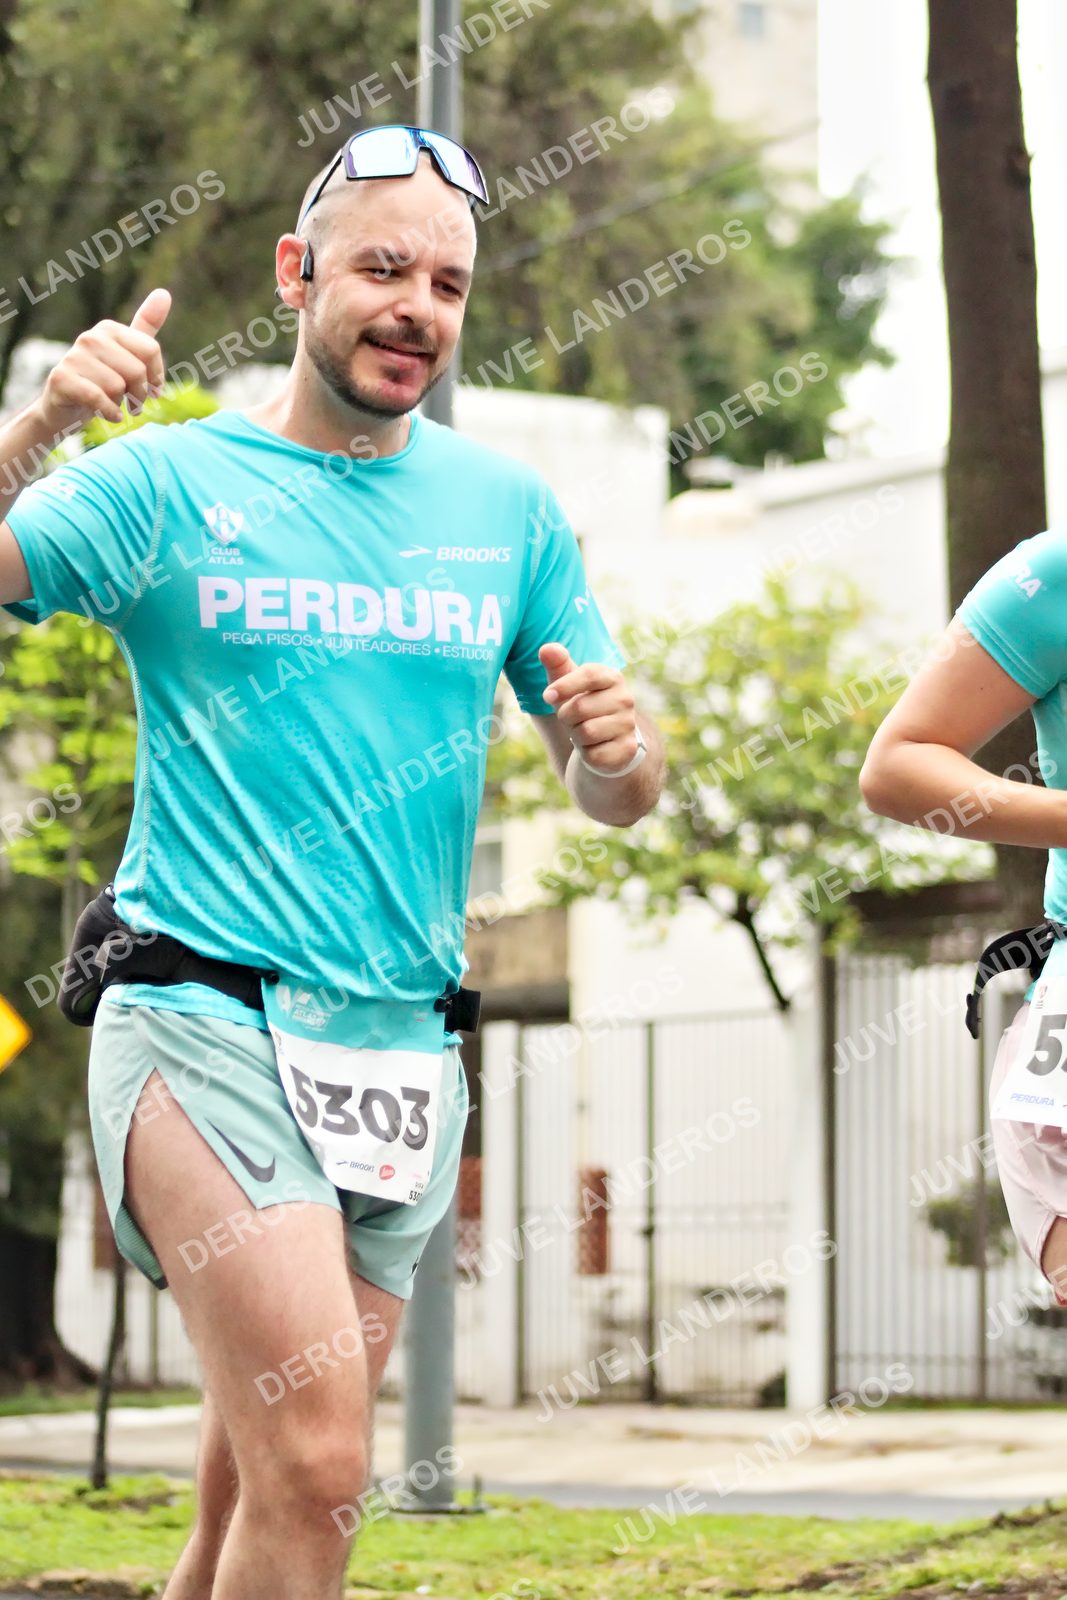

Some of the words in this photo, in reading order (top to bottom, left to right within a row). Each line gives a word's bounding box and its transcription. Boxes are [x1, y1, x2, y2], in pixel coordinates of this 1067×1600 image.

[211, 547, 240, 556] CLUB
[436, 546, 512, 563] BROOKS
[208, 556, 244, 565] ATLAS
[222, 632, 263, 645] PEGA
[266, 634, 313, 647] PISOS
[325, 637, 431, 656] JUNTEADORES
[1026, 1013, 1067, 1077] 5
[289, 1063, 430, 1150] 5303
[1010, 1092, 1055, 1107] PERDURA
[408, 1190, 423, 1201] 530
